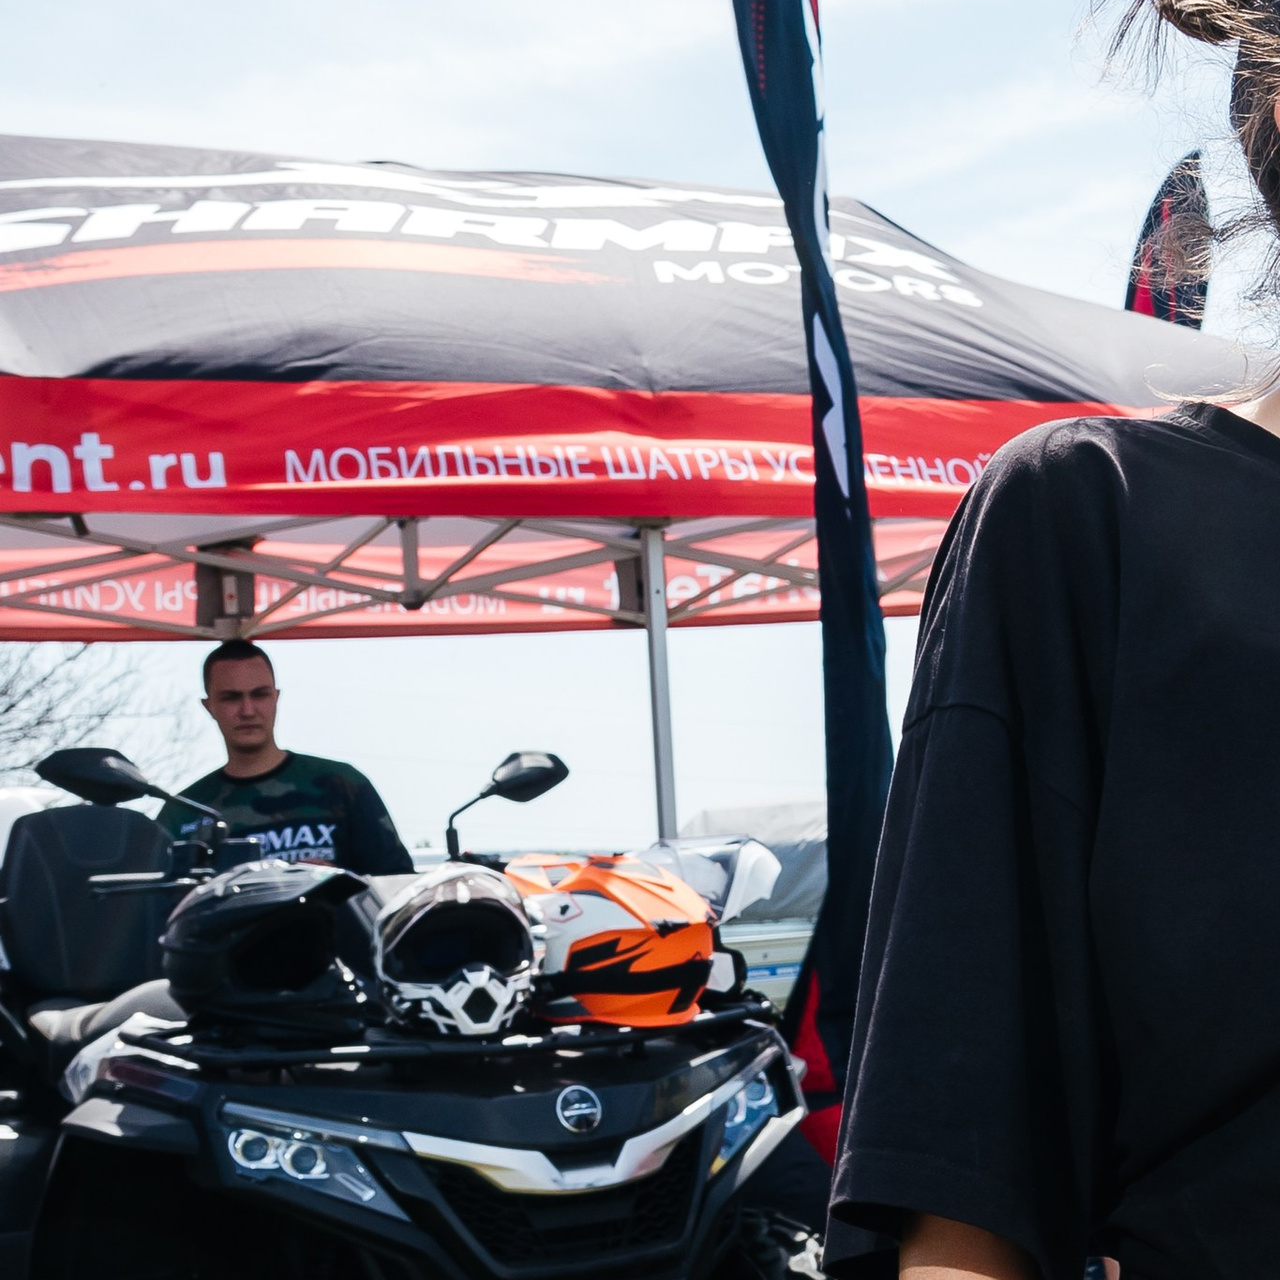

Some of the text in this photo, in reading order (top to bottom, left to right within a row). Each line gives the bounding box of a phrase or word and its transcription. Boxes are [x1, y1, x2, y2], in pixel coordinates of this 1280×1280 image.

[0, 432, 228, 493] nt.ru
[284, 445, 597, 484] МОБИЛЬНЫЕ
[601, 446, 756, 482] ШАТРЫ
